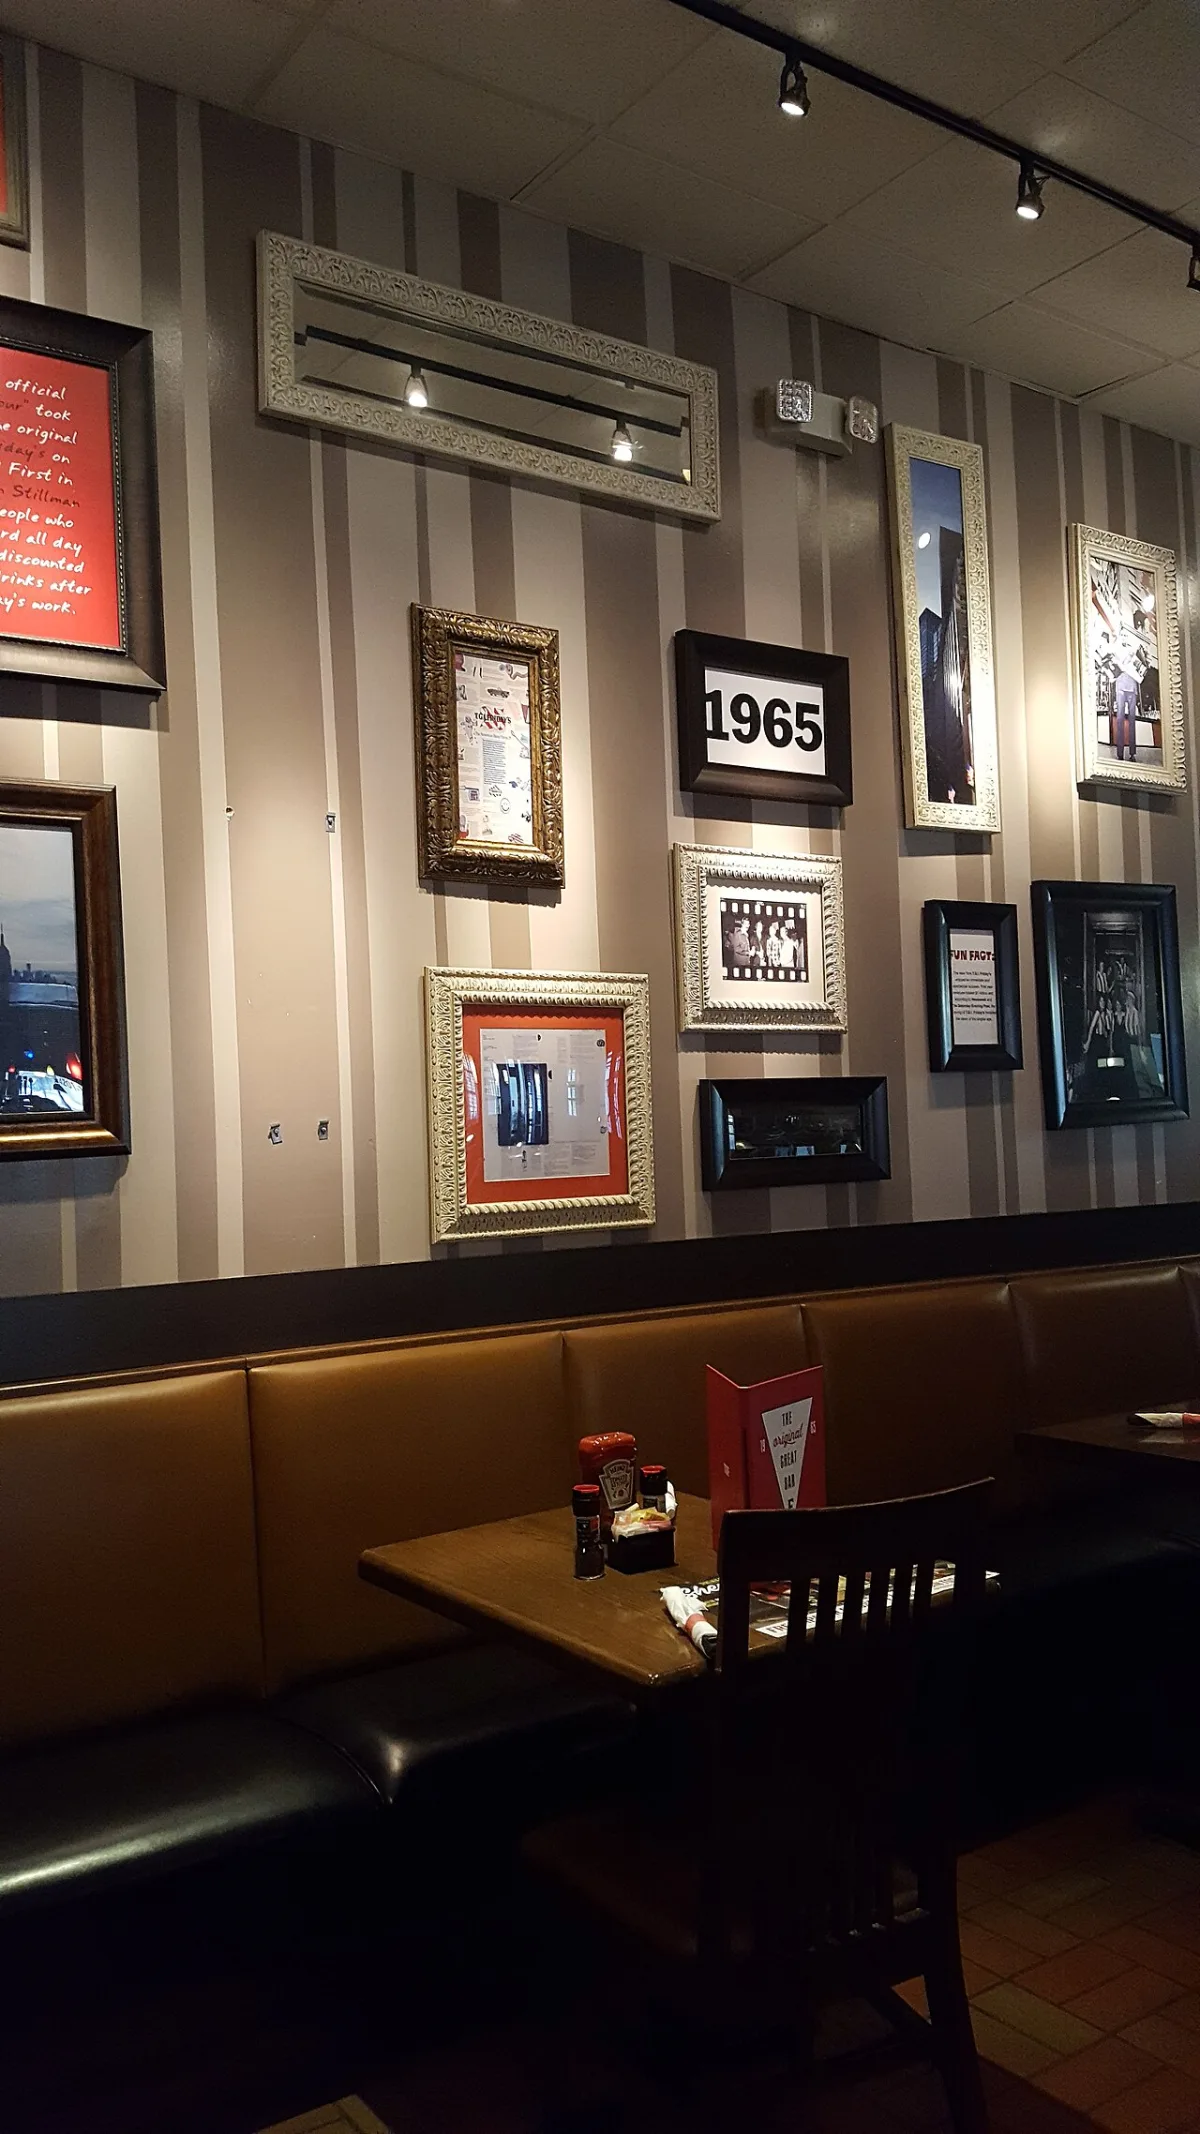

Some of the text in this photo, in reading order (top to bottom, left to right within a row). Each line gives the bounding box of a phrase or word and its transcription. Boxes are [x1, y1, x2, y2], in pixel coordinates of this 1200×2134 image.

[5, 378, 66, 400] official
[35, 404, 71, 421] took
[17, 425, 78, 445] original
[52, 454, 71, 464] on
[8, 461, 73, 486] First in
[12, 484, 80, 508] Stillman
[45, 513, 74, 528] who
[26, 531, 48, 546] all
[53, 536, 82, 558] day
[0, 548, 85, 573] discounted
[49, 579, 92, 595] after
[31, 601, 76, 615] work.
[704, 689, 823, 752] 1965
[949, 950, 968, 961] FUN
[781, 1411, 792, 1427] THE
[773, 1422, 804, 1448] original
[780, 1450, 797, 1469] GREAT
[784, 1473, 796, 1491] BAR
